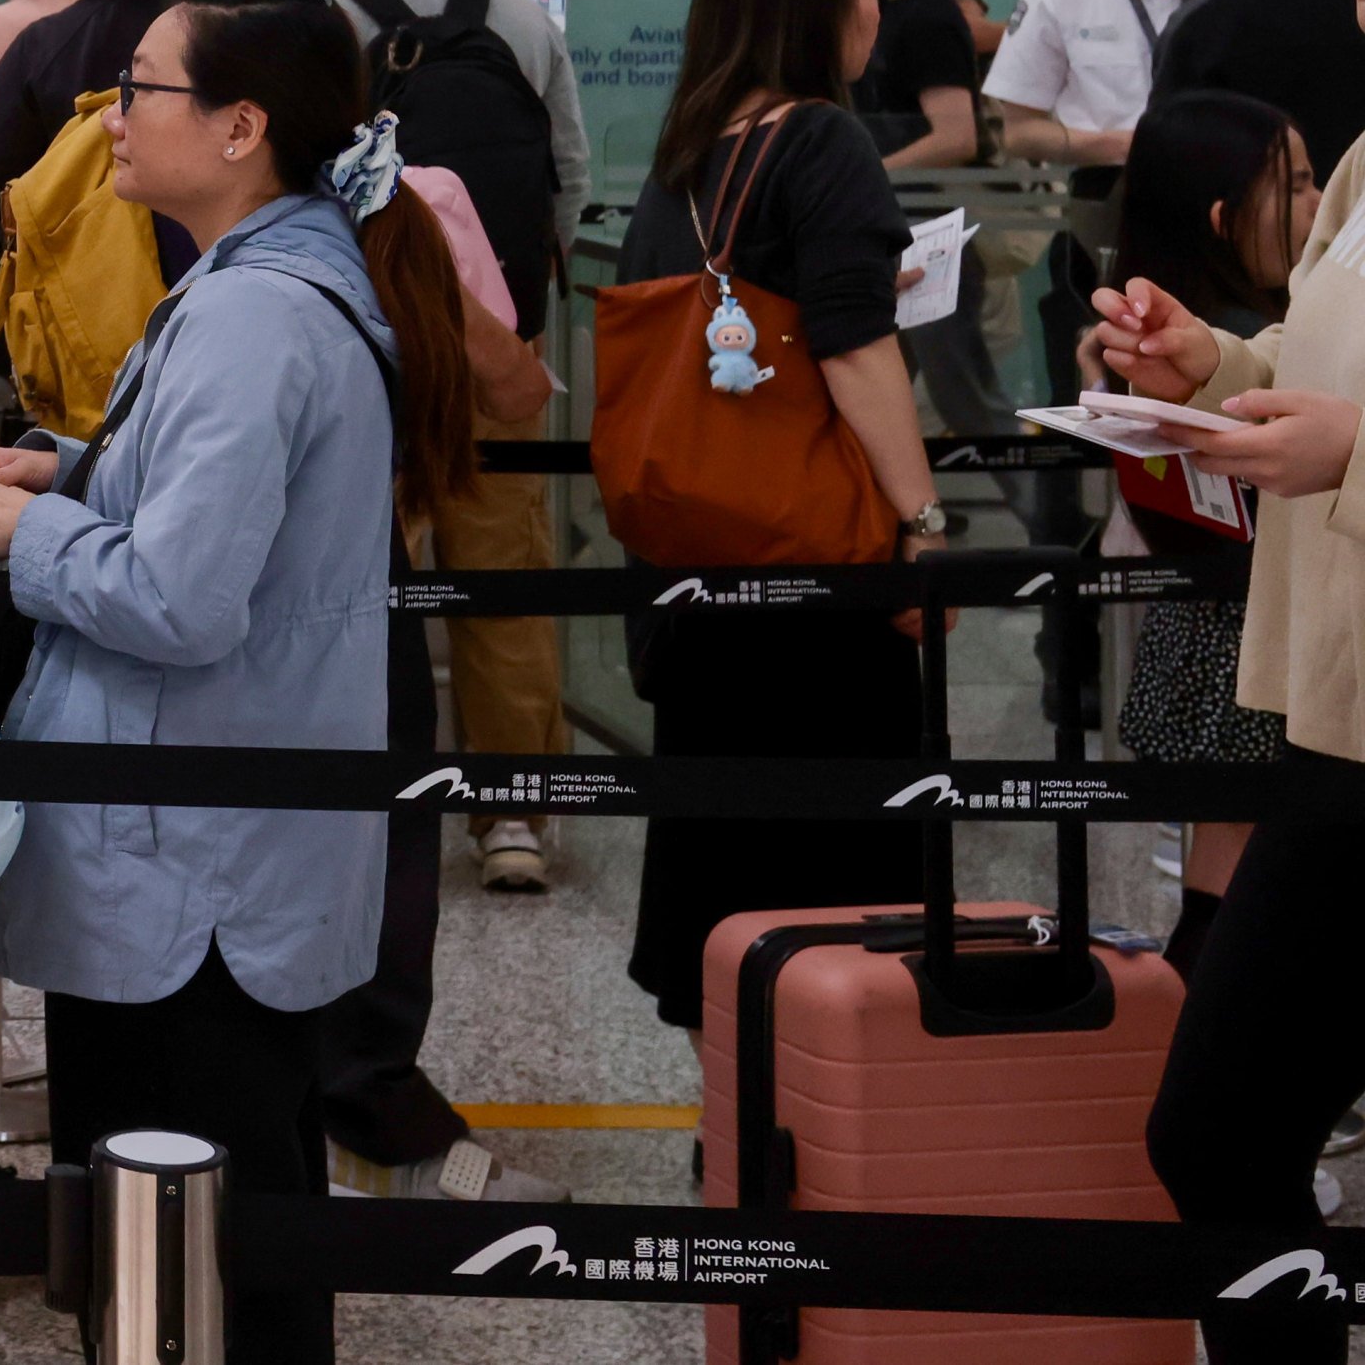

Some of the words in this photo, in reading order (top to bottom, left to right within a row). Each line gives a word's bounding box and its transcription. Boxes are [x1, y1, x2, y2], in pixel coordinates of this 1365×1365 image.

[581, 69, 619, 86] and
[512, 774, 541, 787] 香港
[550, 774, 582, 782] HONG
[585, 775, 616, 783] KONG
[1040, 780, 1072, 789] HONG
[1076, 781, 1107, 789] KONG
[550, 785, 636, 794] INTERNATIONAL
[1002, 780, 1031, 794] 香港
[550, 795, 597, 803] AIRPORT
[1040, 790, 1129, 799] INTERNATIONAL
[1040, 801, 1089, 809] AIRPORT
[634, 1237, 680, 1259] 香港
[693, 1238, 743, 1251] HONG
[748, 1240, 796, 1252] KONG
[693, 1255, 831, 1270] INTERNATIONAL
[585, 1259, 679, 1282] 國際機場
[693, 1272, 768, 1284] AIRPORT
